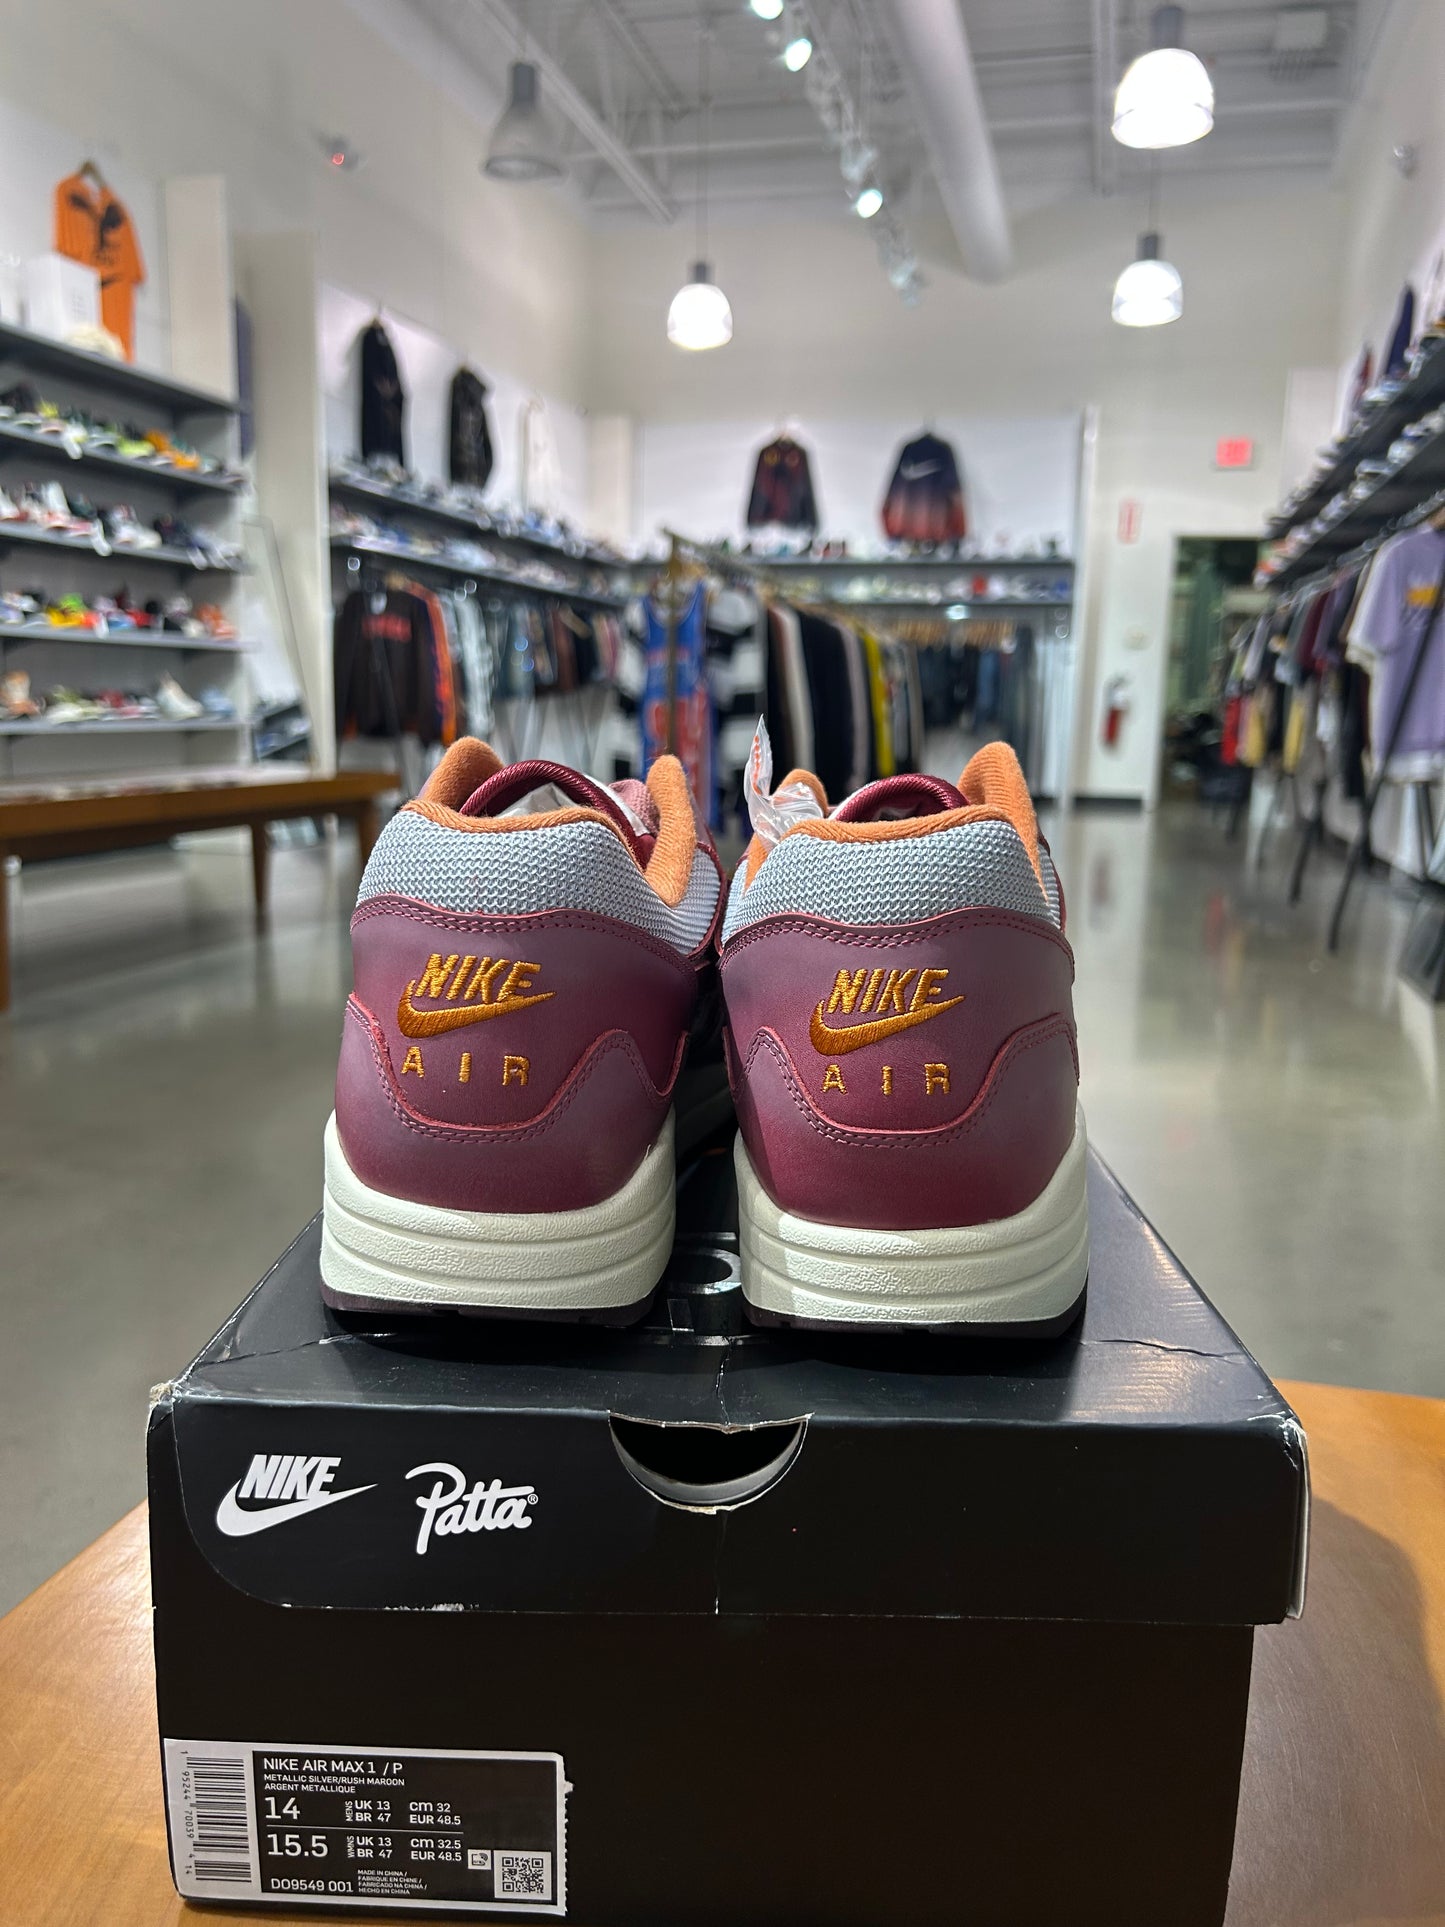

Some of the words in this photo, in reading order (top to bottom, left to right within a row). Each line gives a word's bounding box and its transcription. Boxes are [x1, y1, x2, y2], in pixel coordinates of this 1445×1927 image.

[414, 953, 541, 1004] NIKE
[826, 968, 949, 1014] NIKE
[401, 1046, 530, 1086] AIR
[821, 1062, 950, 1095] AIR
[238, 1454, 341, 1500] NIKE
[263, 1758, 299, 1771] NIKE
[302, 1759, 328, 1772] AIR
[331, 1760, 364, 1773] MAX
[367, 1761, 376, 1774] 1
[182, 1771, 191, 1800] 95244
[263, 1774, 307, 1783] METALLIC
[308, 1775, 365, 1785] SILVER/RUSH
[366, 1777, 405, 1786] MAROON
[264, 1783, 299, 1791] ARGENT
[301, 1784, 356, 1793] METALLIQUE
[264, 1796, 300, 1820] 14
[345, 1800, 353, 1822] MENS
[354, 1800, 373, 1810] UK
[376, 1800, 391, 1810] 13
[409, 1801, 433, 1812] cm
[436, 1802, 451, 1813] 32
[184, 1810, 194, 1838] 70039
[355, 1812, 372, 1822] BR
[377, 1812, 391, 1823] 47
[409, 1814, 435, 1825] EUR
[437, 1814, 461, 1825] 48.5
[266, 1833, 329, 1858] 15.5
[346, 1835, 355, 1858] WMNS
[356, 1836, 374, 1846] UK
[378, 1837, 392, 1847] 13
[410, 1838, 434, 1848] cm
[437, 1839, 461, 1849] 32.5
[356, 1848, 374, 1858] BR
[378, 1849, 393, 1859] 47
[410, 1850, 436, 1860] EUR
[438, 1851, 462, 1861] 48.5
[328, 1880, 353, 1893] 001
